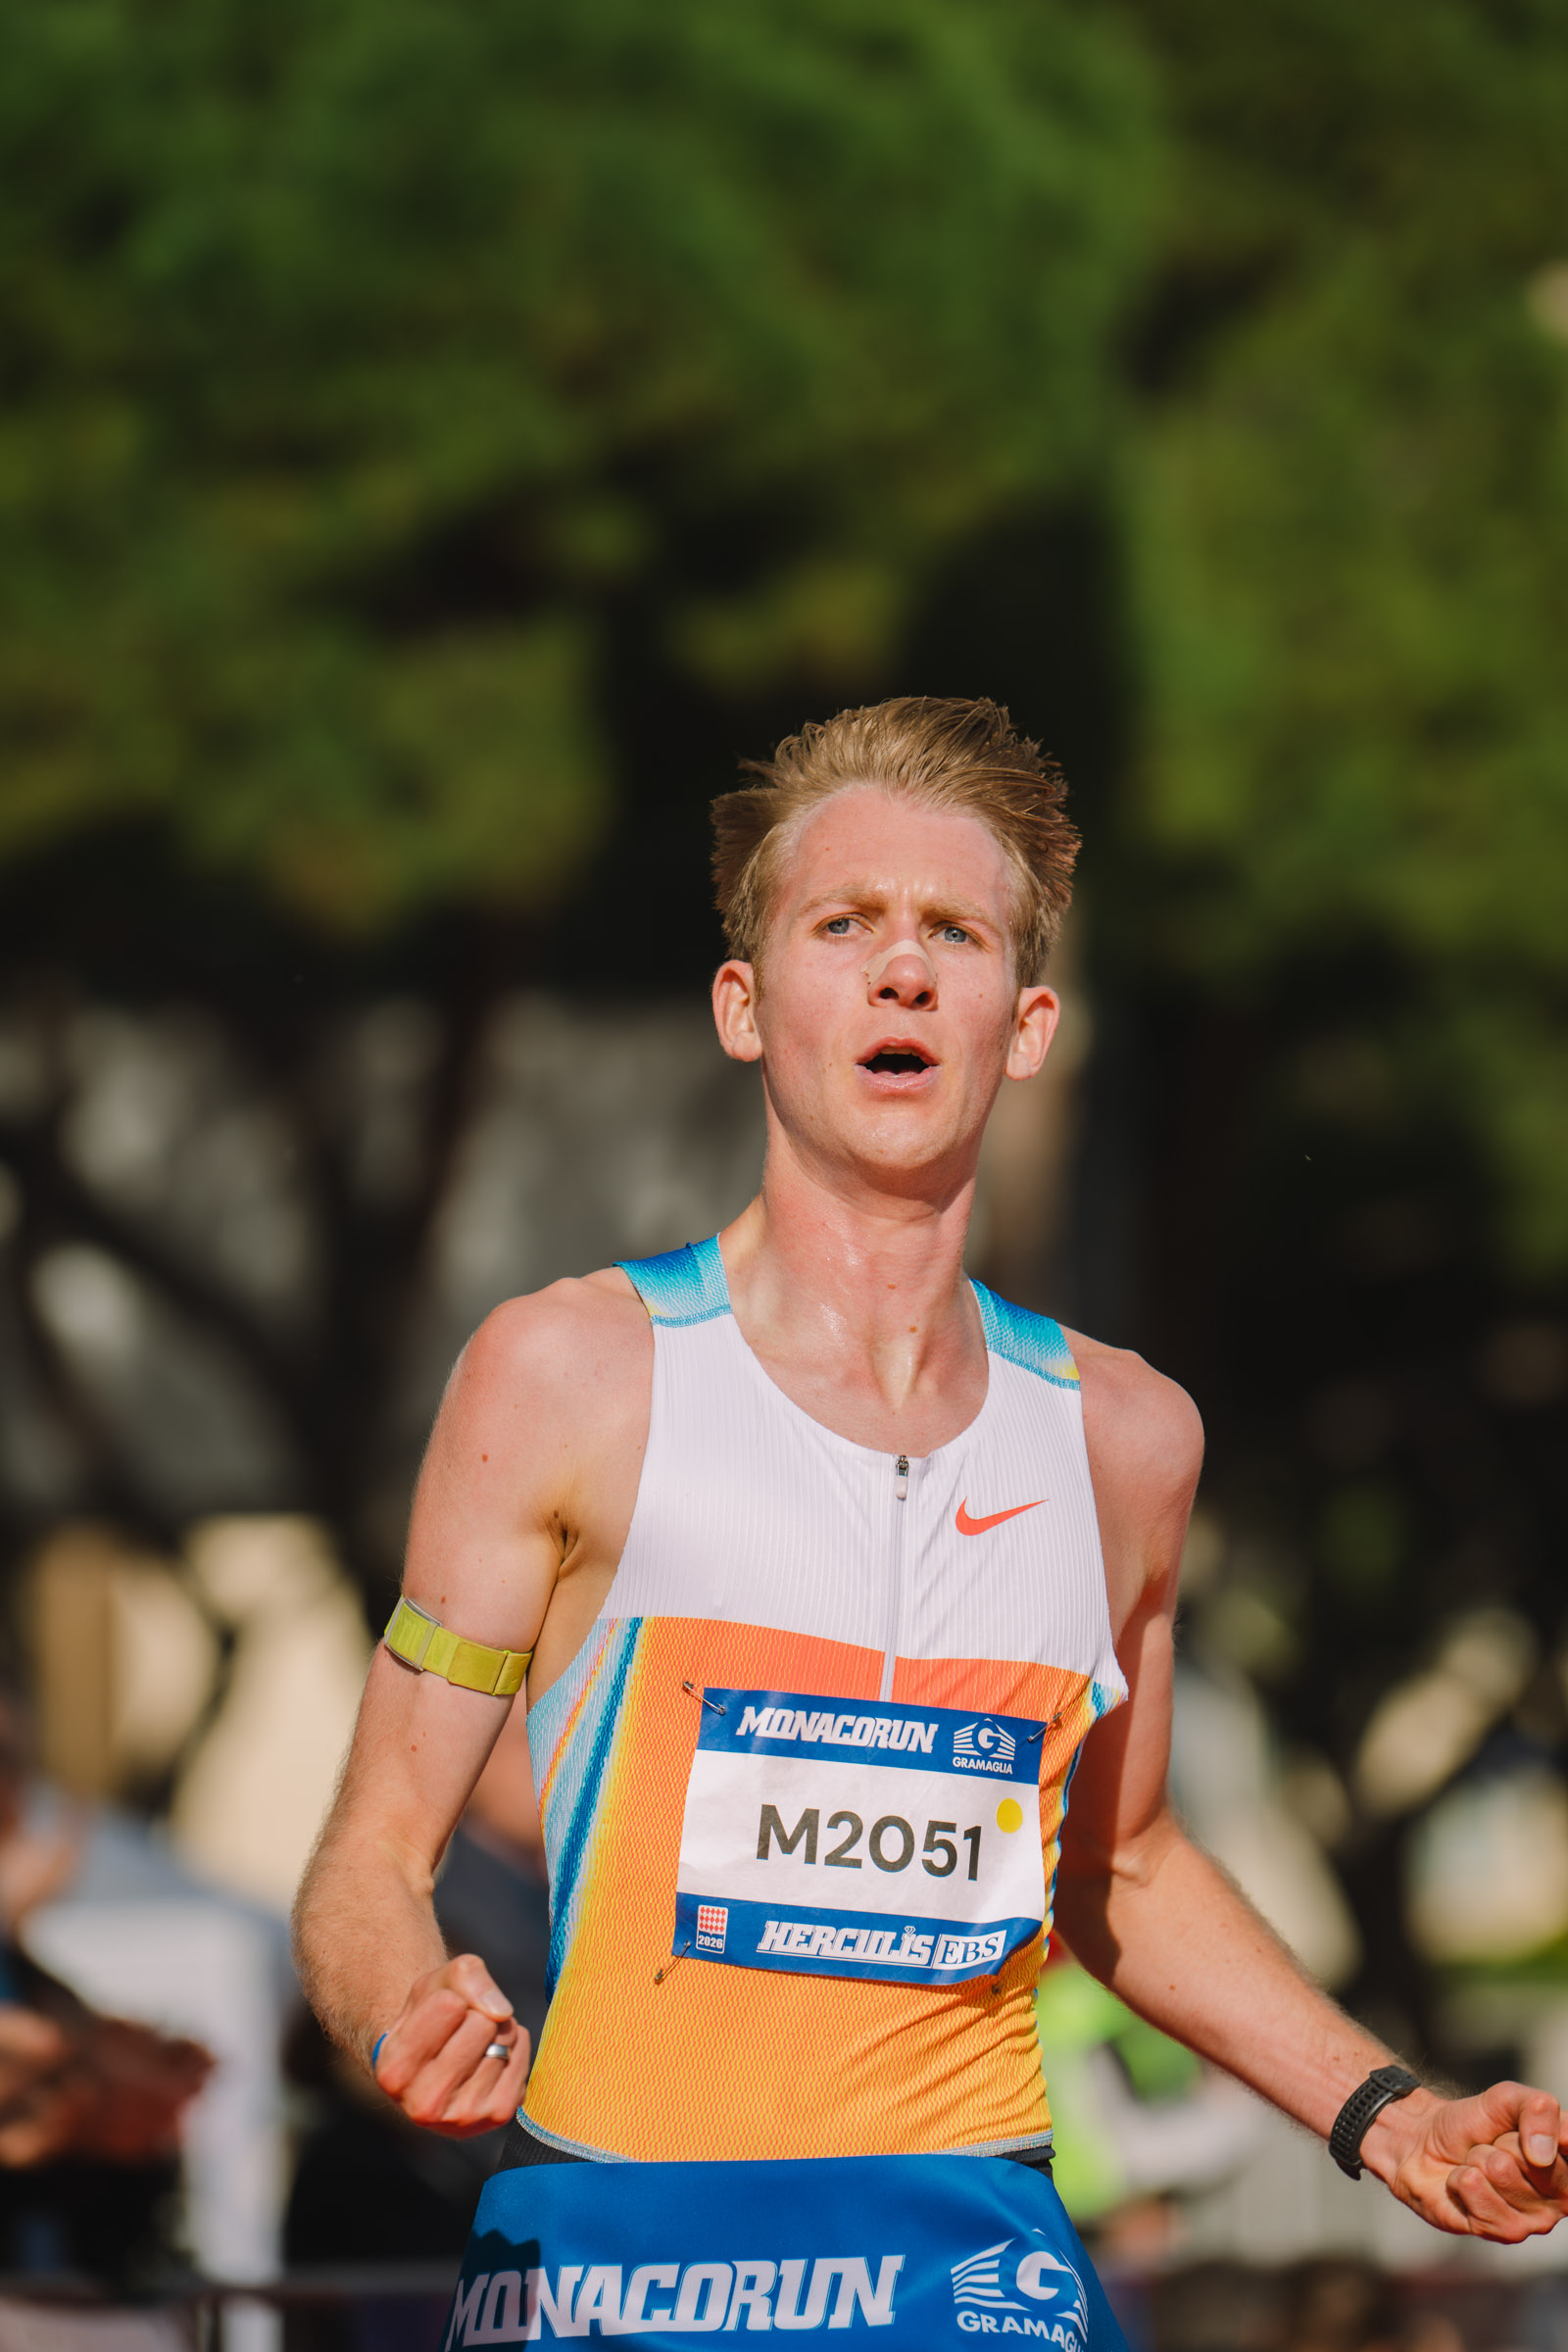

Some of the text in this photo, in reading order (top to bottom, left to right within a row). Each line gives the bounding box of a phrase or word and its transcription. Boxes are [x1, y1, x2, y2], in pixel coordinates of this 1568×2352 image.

[736, 1706, 939, 1753] MONACORUN
[952, 1756, 1013, 1775] GRAMAGLIA
[756, 1803, 982, 1882] M2051
[698, 1935, 723, 1949] 2026
[940, 1936, 1000, 1965] EBS
[444, 2255, 906, 2352] MONACORUN
